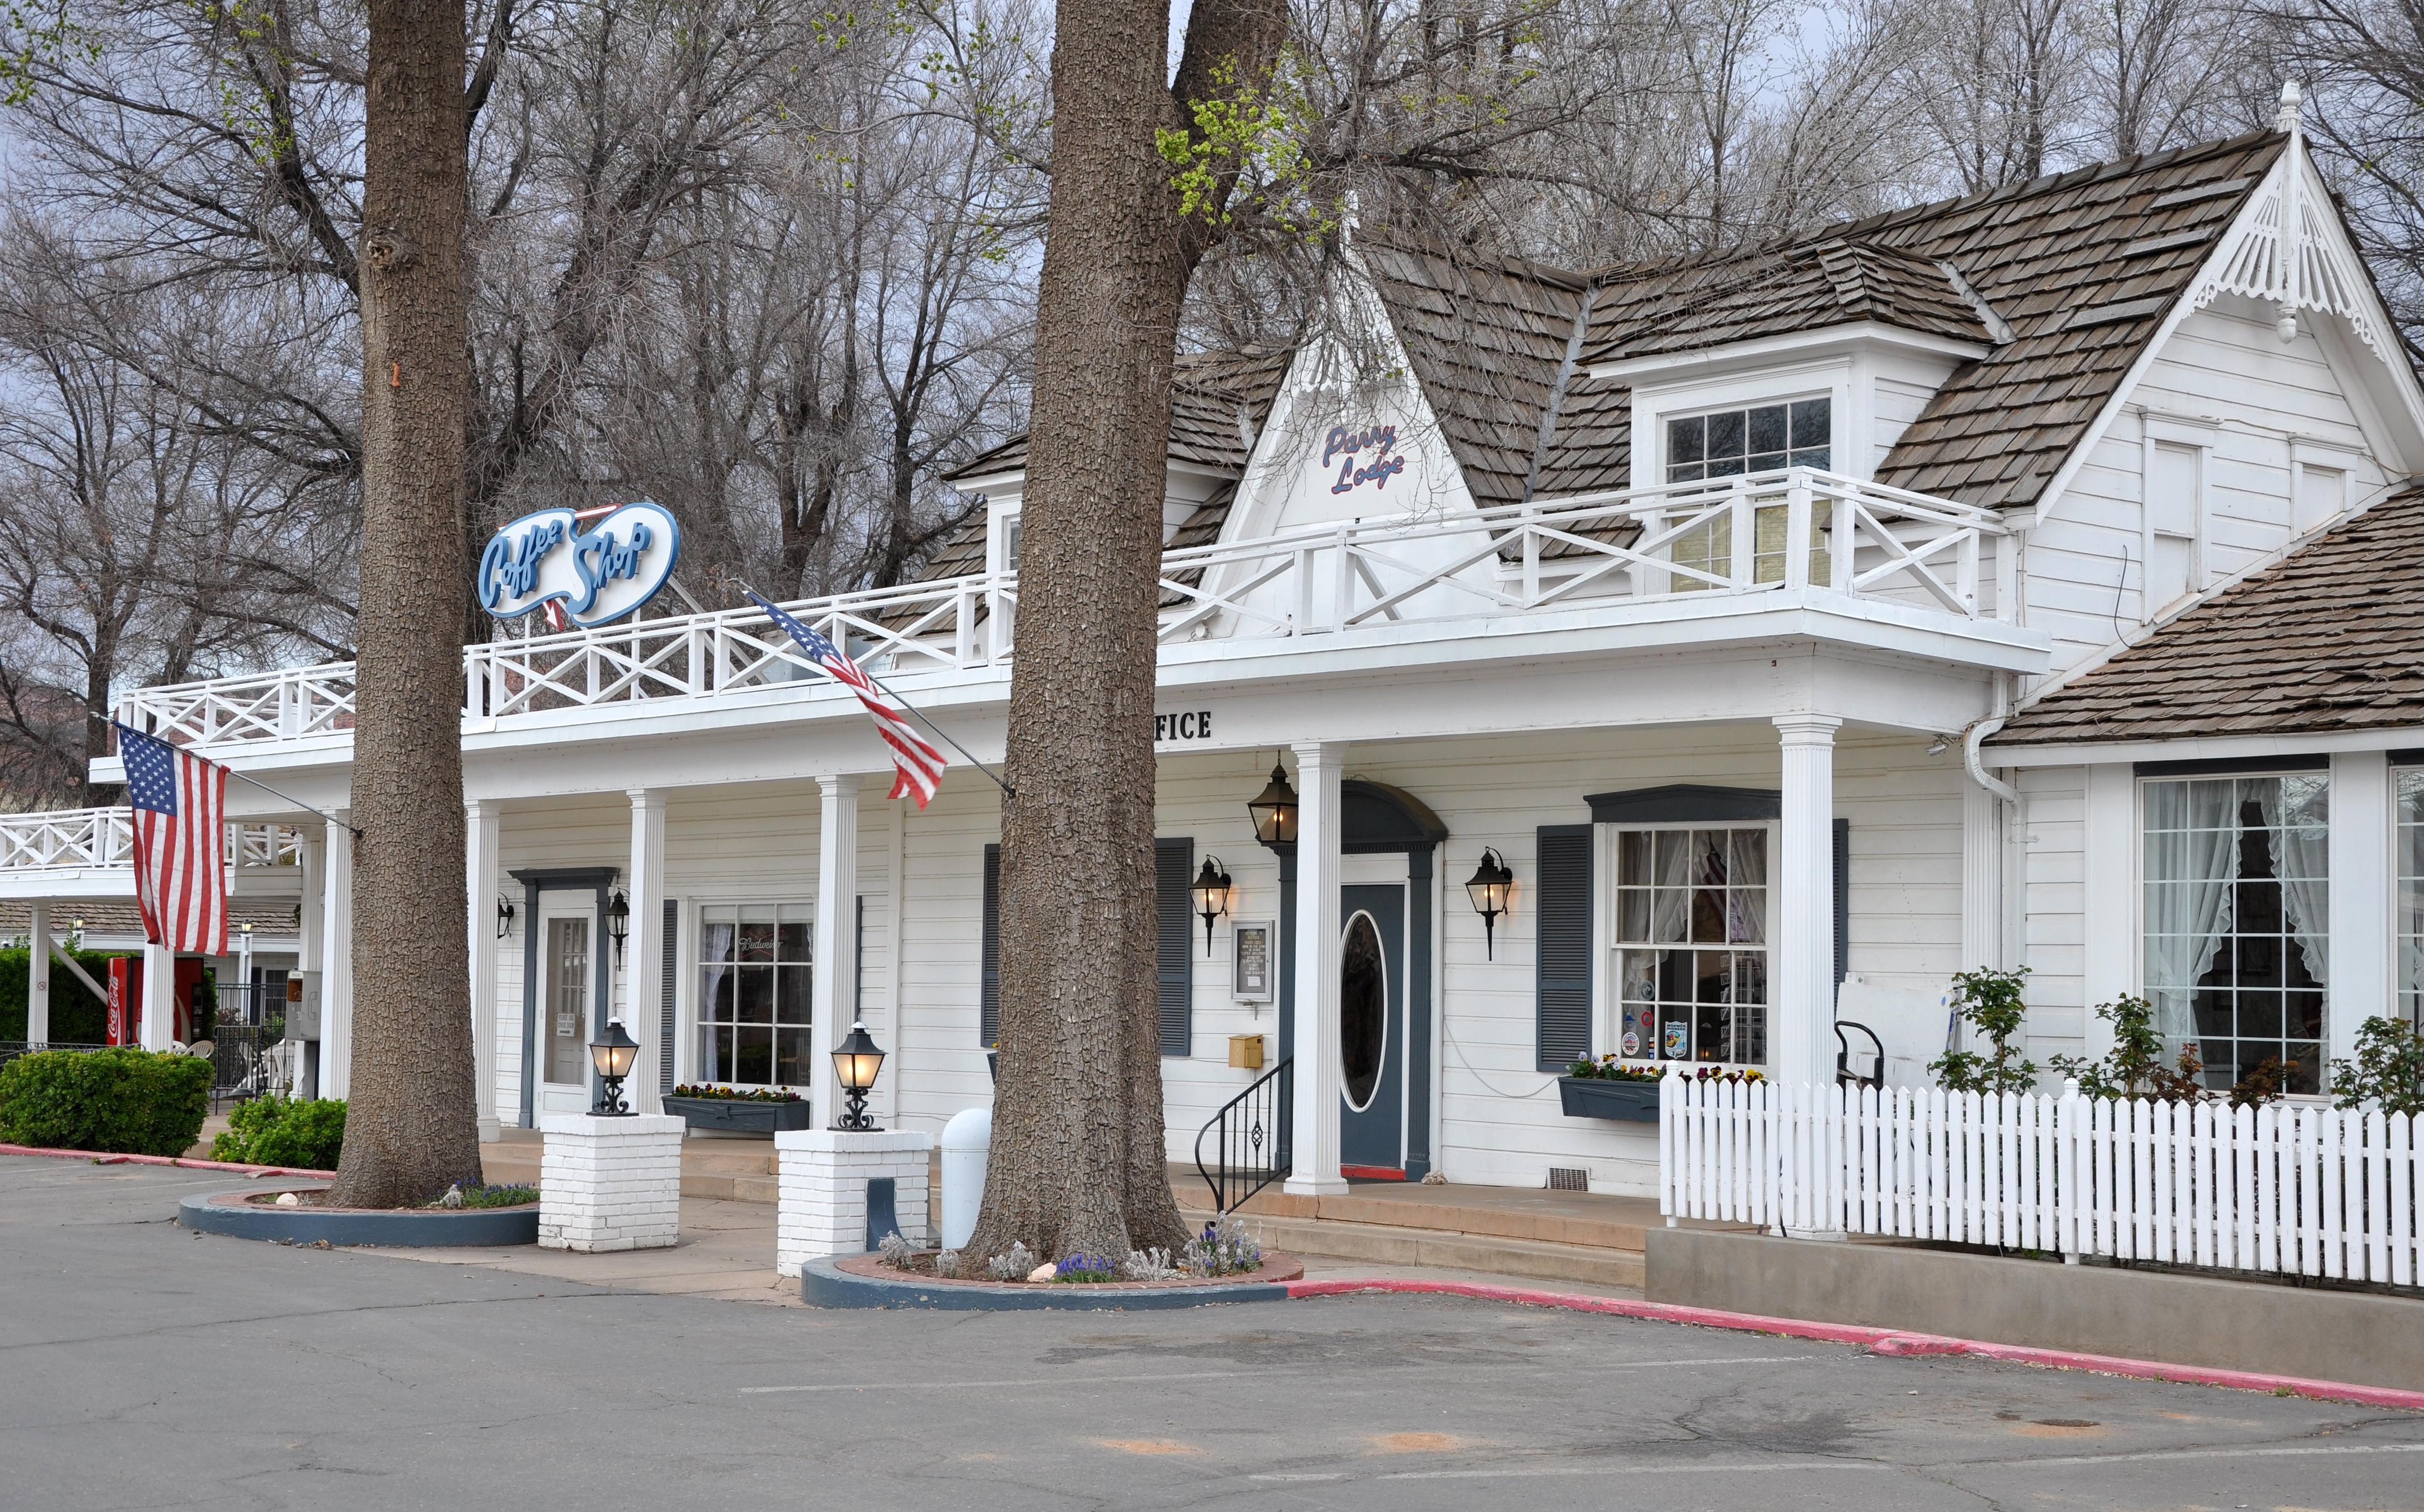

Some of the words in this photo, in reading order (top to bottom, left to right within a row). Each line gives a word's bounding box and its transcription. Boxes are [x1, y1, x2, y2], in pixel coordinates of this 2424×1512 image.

[1331, 455, 1405, 495] Lodge
[478, 519, 563, 609] Coffee
[566, 522, 651, 615] Shop
[1154, 711, 1211, 741] FICE
[108, 975, 118, 1038] Coca-Cola
